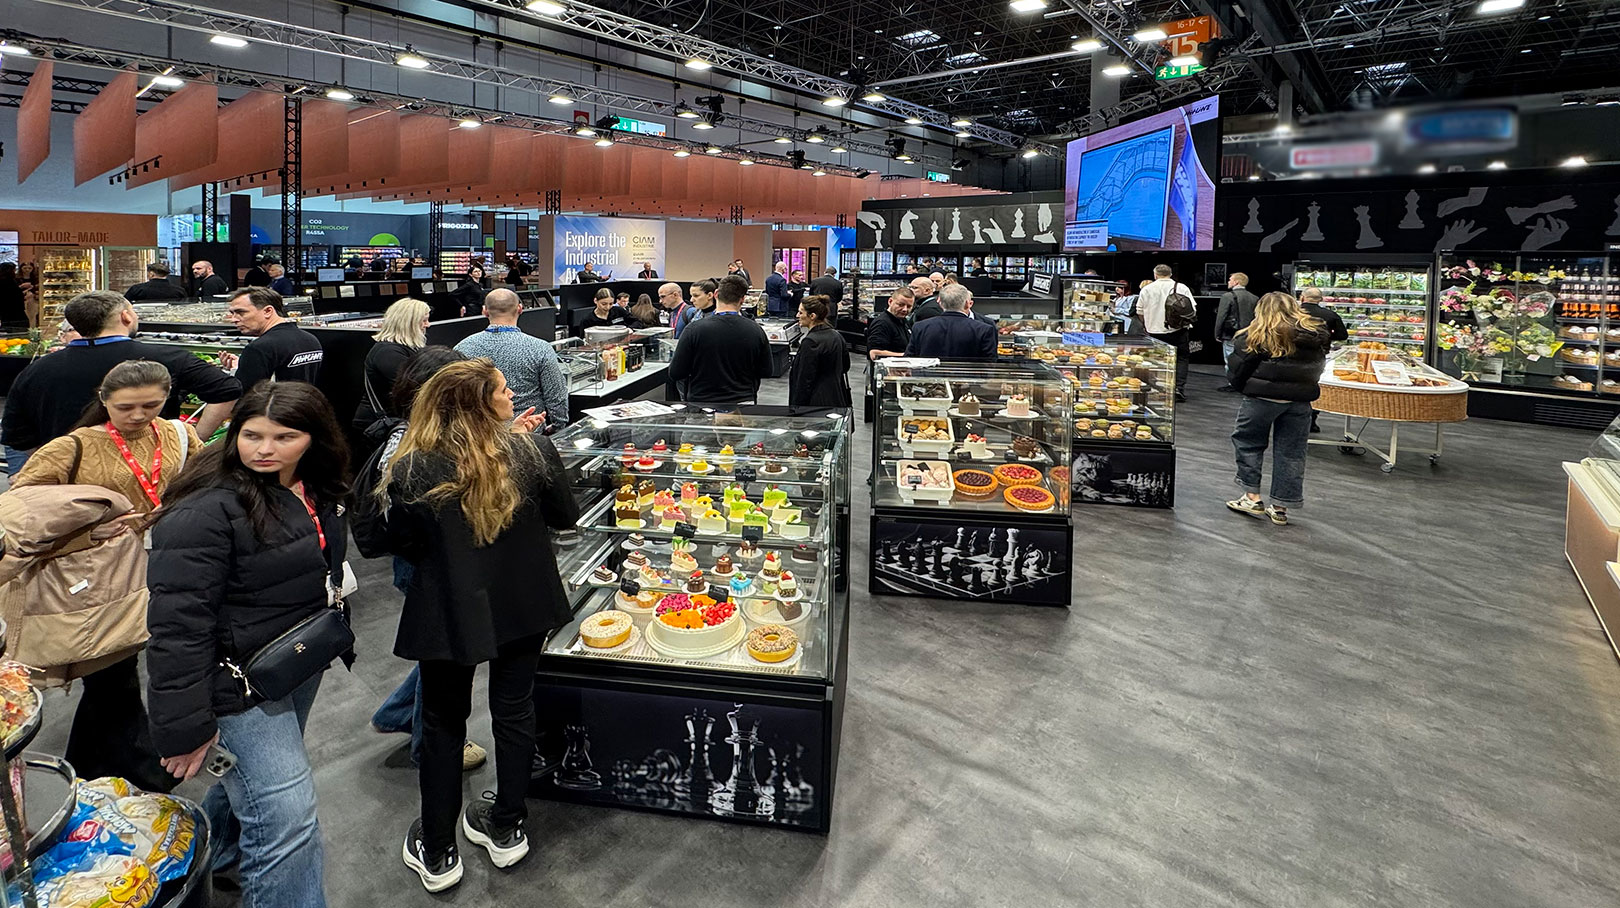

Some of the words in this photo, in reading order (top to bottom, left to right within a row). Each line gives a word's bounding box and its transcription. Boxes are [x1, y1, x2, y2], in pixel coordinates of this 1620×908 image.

[1166, 36, 1198, 57] 15
[31, 231, 109, 243] TAILOR-MADE
[565, 231, 606, 250] Explore
[608, 232, 626, 248] the
[632, 236, 656, 244] CIAM
[565, 249, 619, 265] Industrial
